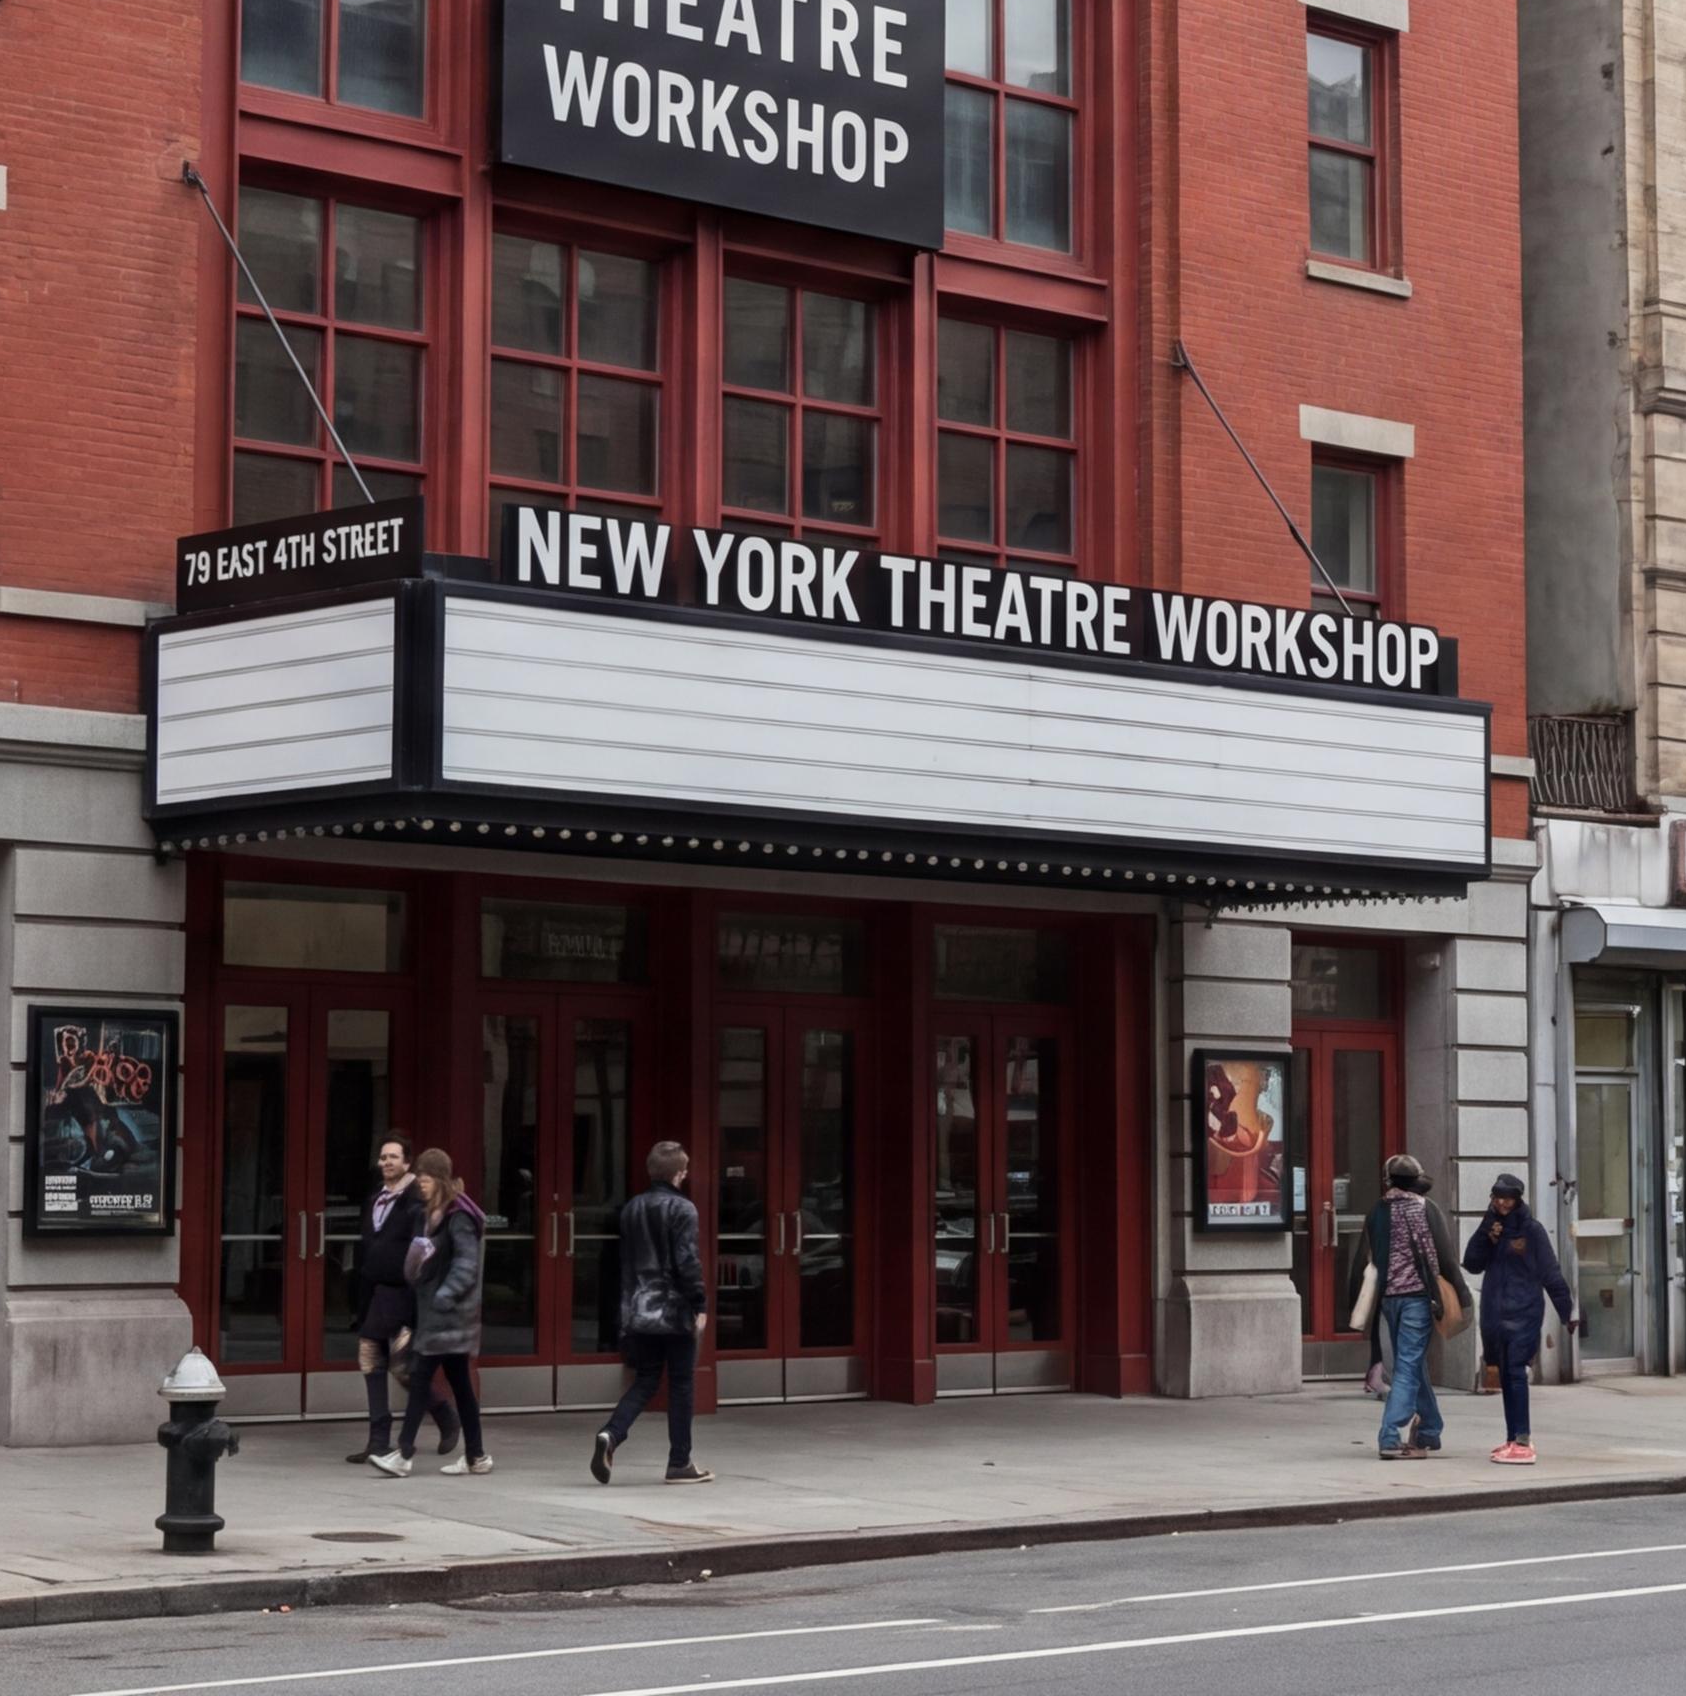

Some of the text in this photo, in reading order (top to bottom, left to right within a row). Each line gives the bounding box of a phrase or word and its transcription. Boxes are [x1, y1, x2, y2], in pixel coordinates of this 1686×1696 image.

[542, 43, 909, 188] WORKSHOP
[184, 517, 404, 586] 79 EAST 4TH STREET
[517, 506, 1439, 690] NEW YORK THEATRE WORKSHOP
